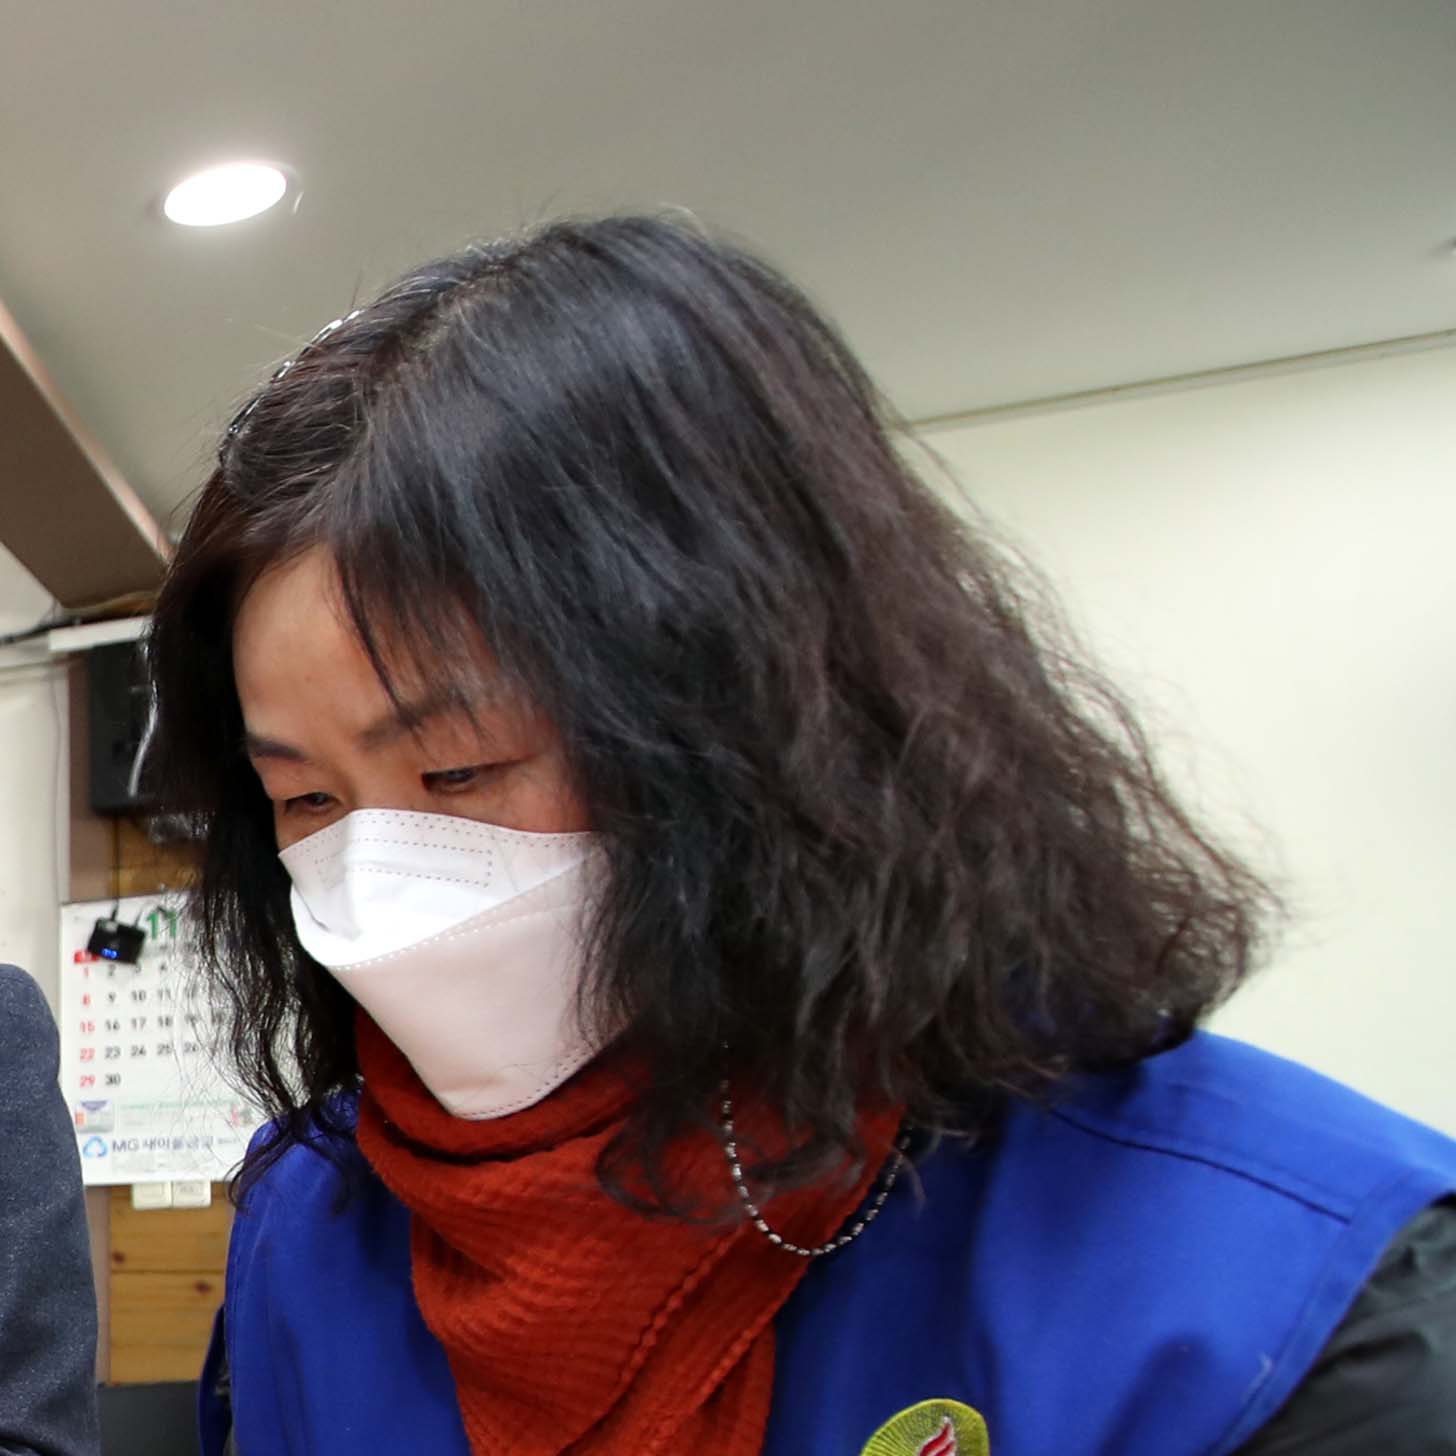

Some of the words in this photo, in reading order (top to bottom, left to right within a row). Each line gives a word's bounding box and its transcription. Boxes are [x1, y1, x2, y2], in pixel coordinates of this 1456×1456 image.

[131, 1017, 146, 1029] 17
[105, 1046, 120, 1059] 23
[105, 1073, 121, 1086] 30
